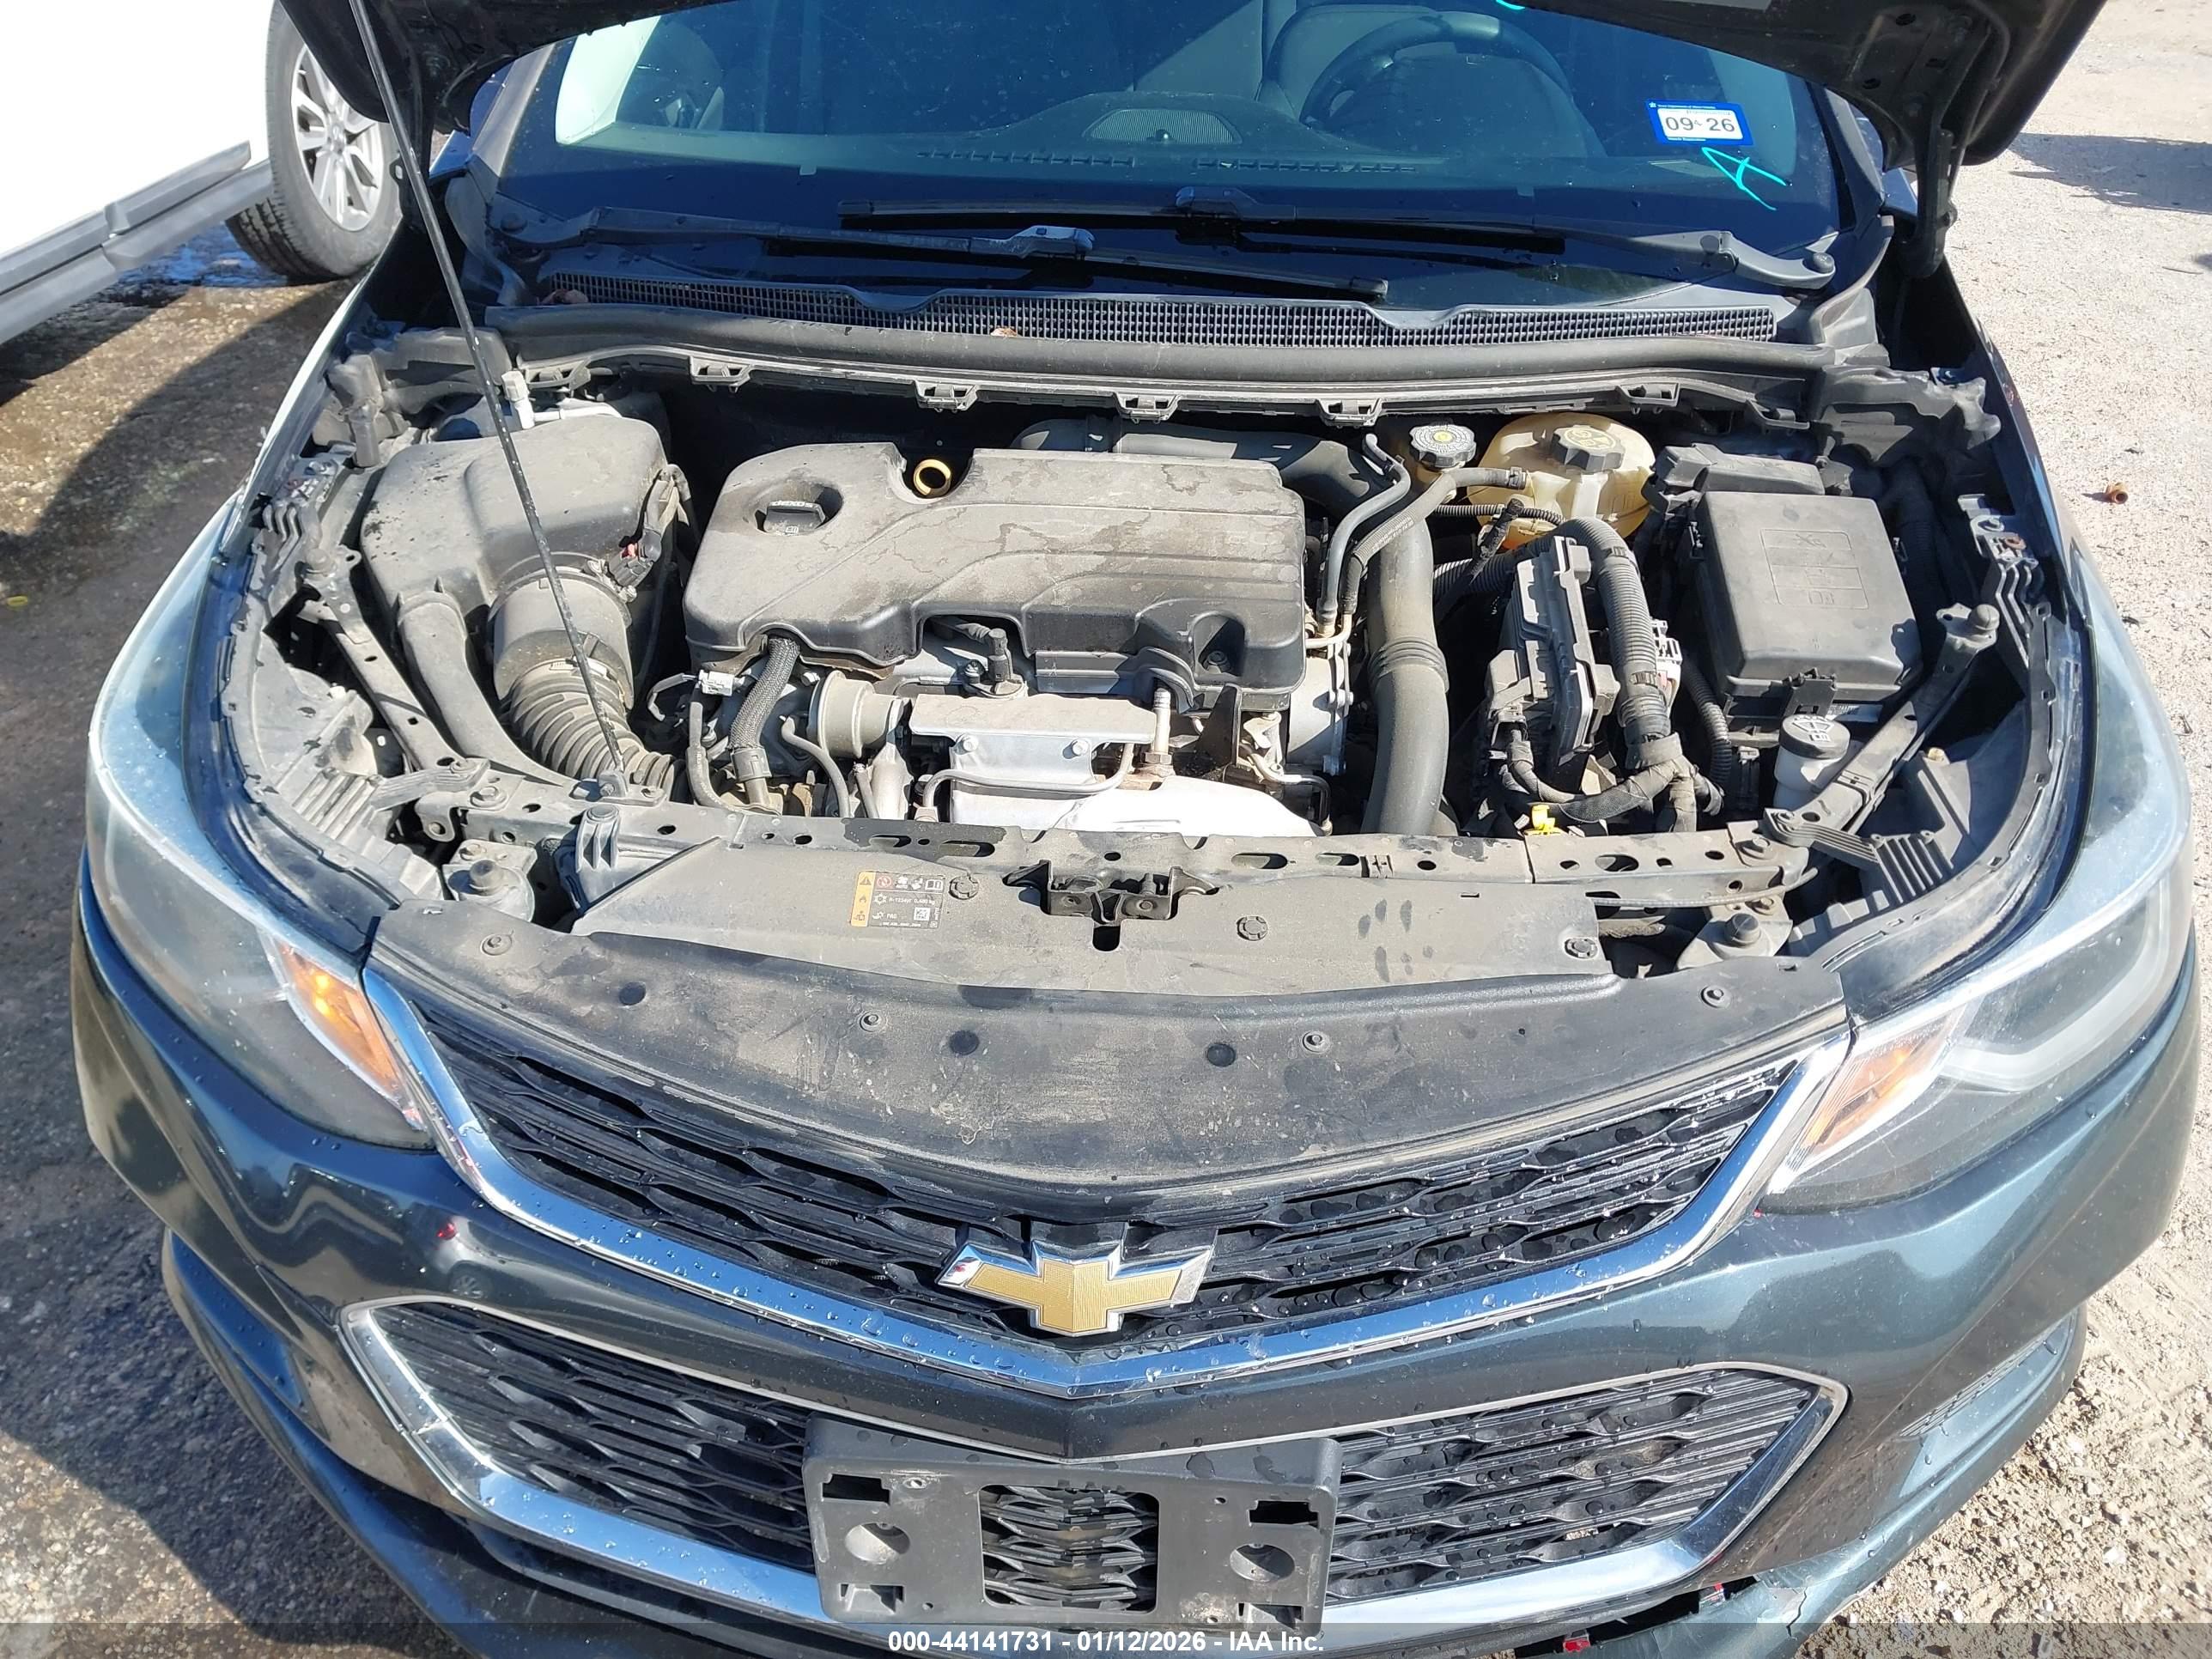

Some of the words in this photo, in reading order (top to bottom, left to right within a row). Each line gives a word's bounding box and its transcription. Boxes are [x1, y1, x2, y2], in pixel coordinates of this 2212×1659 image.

[1665, 117, 1694, 131] 09
[1705, 118, 1735, 132] 26
[771, 500, 813, 508] dexos
